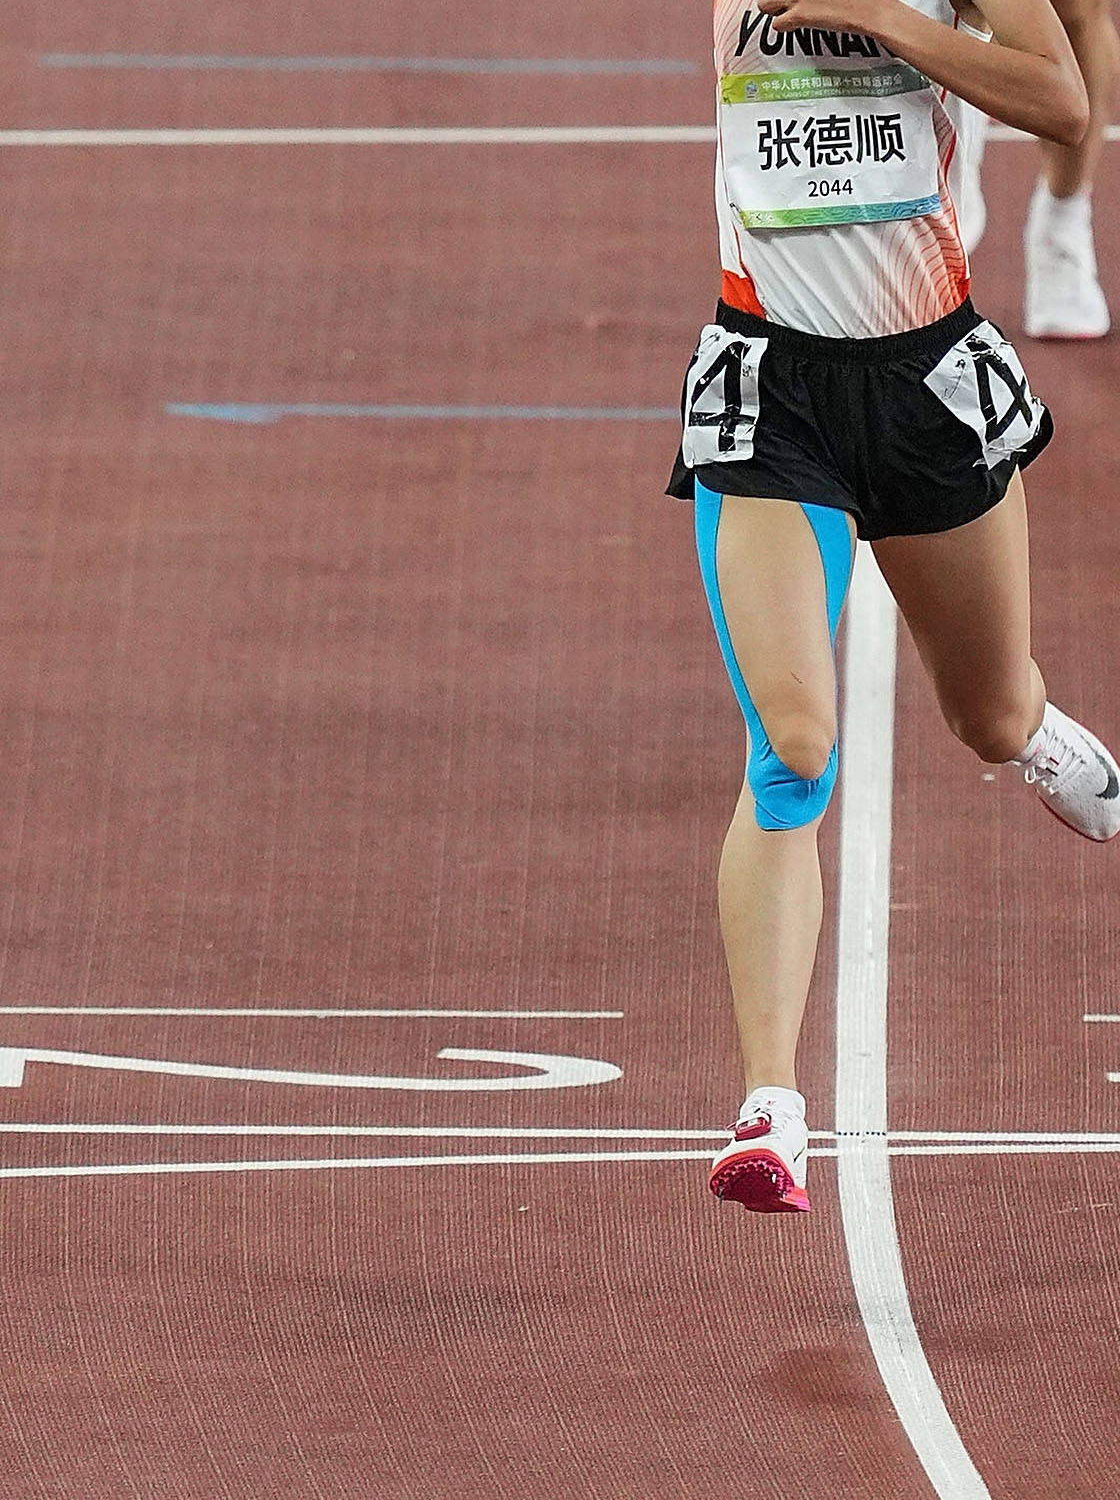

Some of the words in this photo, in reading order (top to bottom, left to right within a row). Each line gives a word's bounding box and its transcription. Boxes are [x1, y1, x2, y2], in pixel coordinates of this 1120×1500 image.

[757, 113, 907, 171] 张德顺
[807, 178, 853, 198] 2044
[688, 340, 757, 452] 4
[964, 332, 1034, 446] 4
